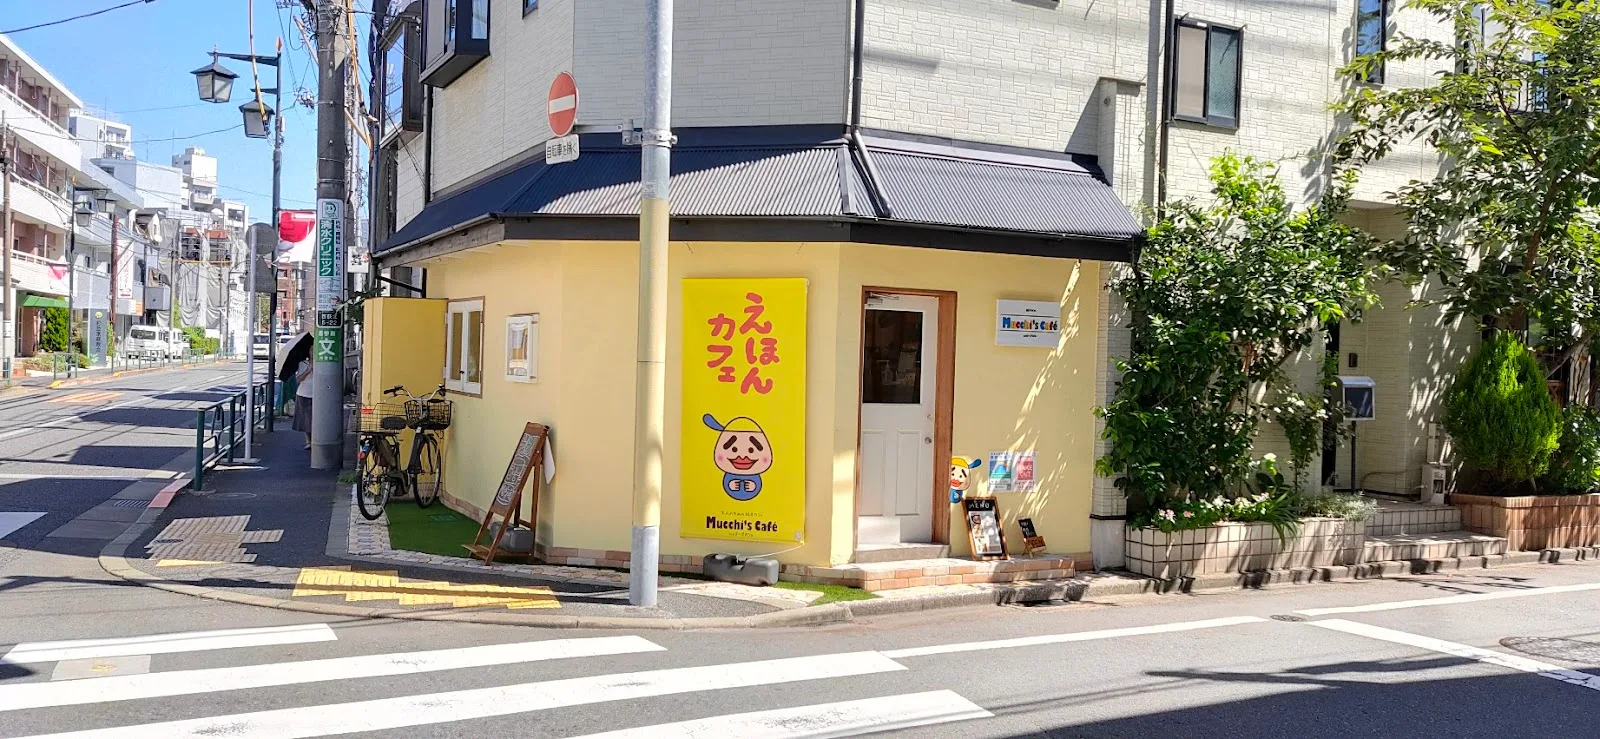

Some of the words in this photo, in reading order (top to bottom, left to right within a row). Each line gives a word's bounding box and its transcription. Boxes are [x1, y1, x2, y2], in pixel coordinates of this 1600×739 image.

[547, 141, 577, 159] 自転車を除く
[320, 220, 333, 276] 清水クリニック
[1002, 317, 1039, 330] Mucchi's
[1040, 320, 1058, 331] Café
[706, 313, 736, 382] カフェ
[739, 292, 780, 394] えほん
[706, 515, 753, 531] Mucchi's
[754, 520, 778, 532] Café
